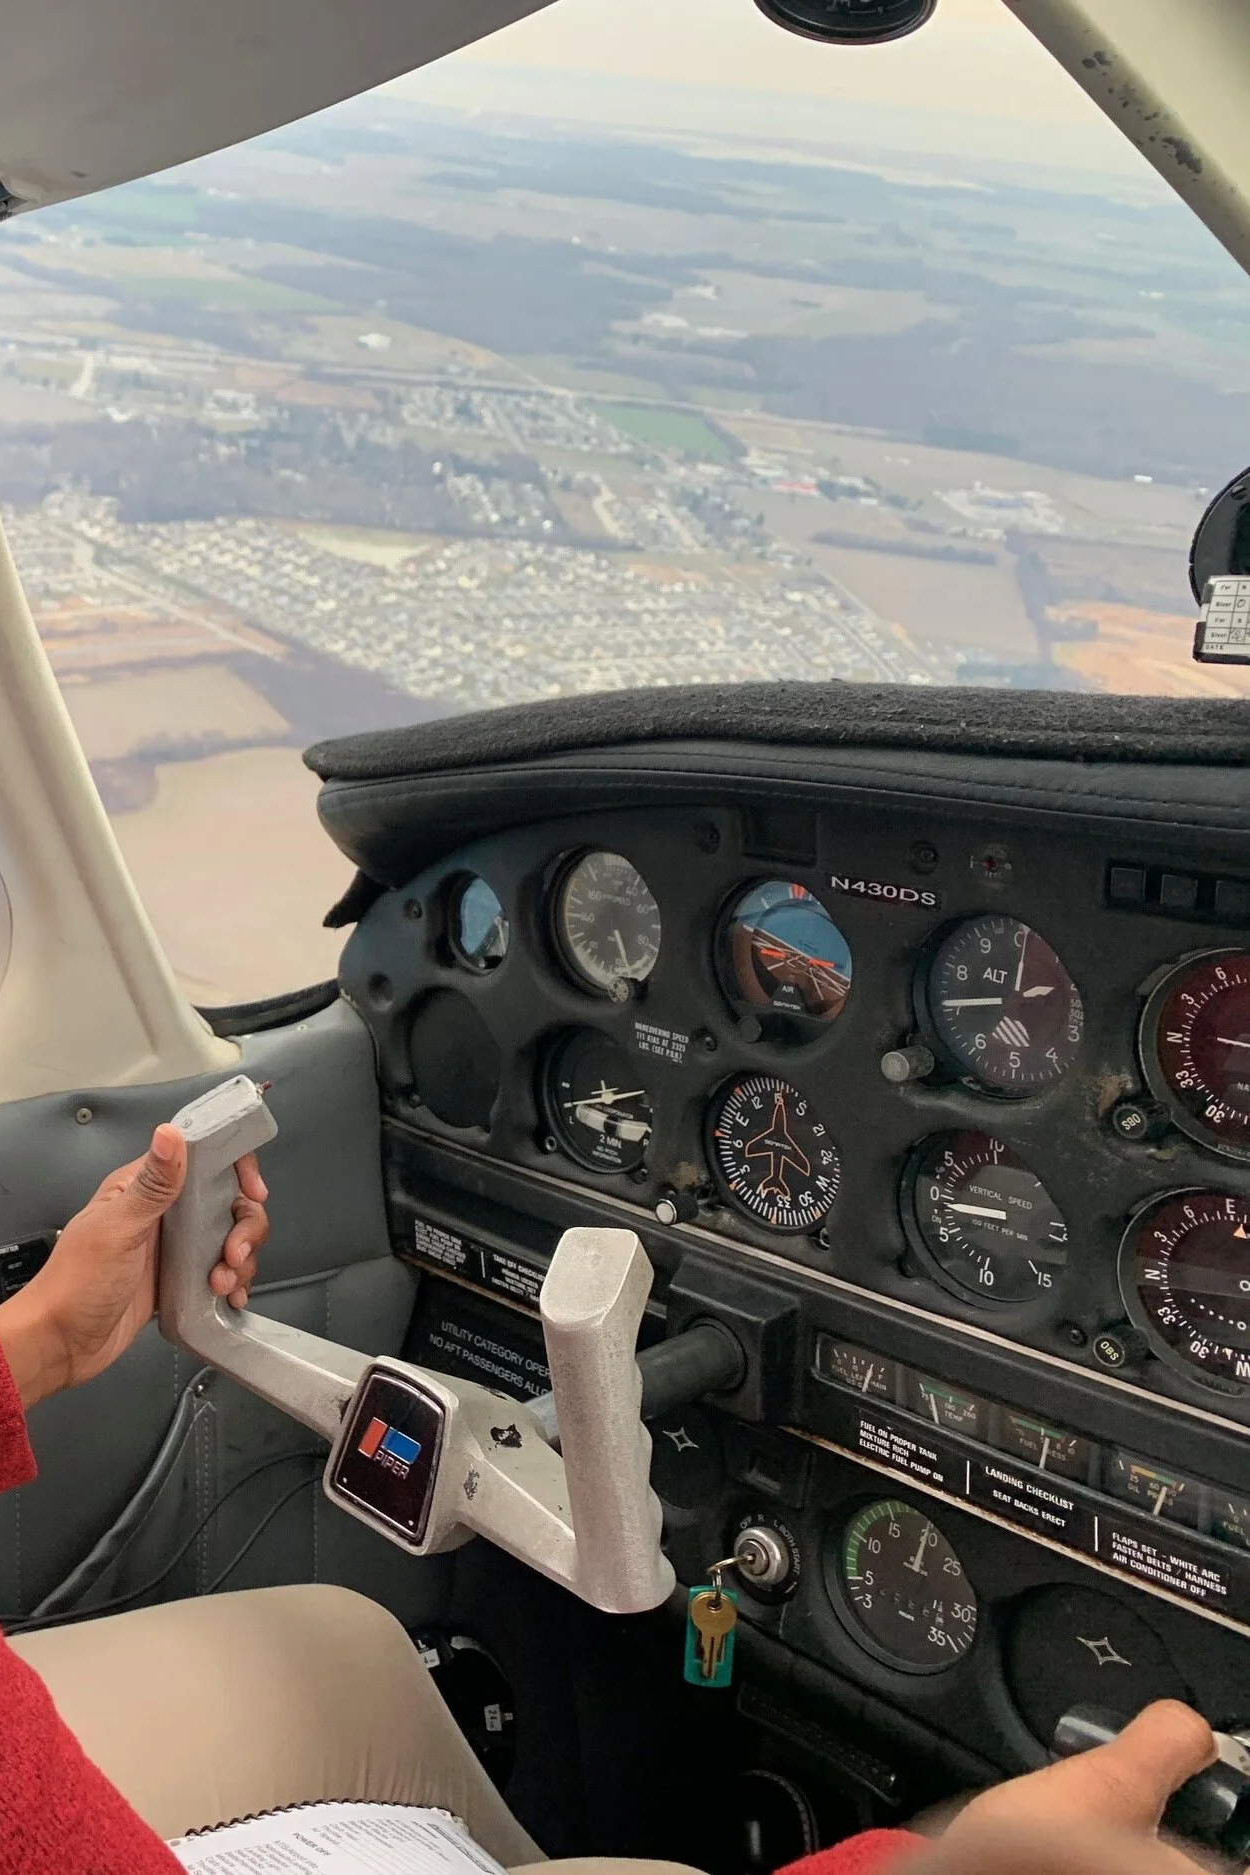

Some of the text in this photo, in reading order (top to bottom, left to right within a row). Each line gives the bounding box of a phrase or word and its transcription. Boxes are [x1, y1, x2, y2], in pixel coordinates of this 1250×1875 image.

[831, 876, 937, 906] N430DS
[637, 904, 648, 914] 60
[980, 938, 991, 954] 9
[957, 965, 968, 981] 8
[983, 967, 1008, 984] ALT
[1215, 967, 1227, 981] 6
[782, 985, 794, 994] AIR
[1181, 993, 1195, 1005] 3
[672, 1032, 689, 1044] SPEED
[1068, 1025, 1080, 1042] 3
[1167, 1032, 1183, 1043] N
[975, 1034, 986, 1050] 6
[1009, 1052, 1021, 1068] 5
[1045, 1048, 1058, 1063] 4
[1176, 1070, 1194, 1089] 33
[751, 1096, 763, 1110] 12
[796, 1102, 807, 1116] S
[570, 1116, 575, 1125] L
[735, 1112, 750, 1127] E
[1205, 1104, 1225, 1123] 30
[813, 1124, 826, 1136] 21
[1121, 1113, 1141, 1131] OBS
[599, 1134, 605, 1143] 2
[732, 1139, 744, 1149] 6
[821, 1150, 833, 1166] 24
[944, 1151, 954, 1166] 5
[739, 1164, 751, 1175] 3
[815, 1175, 831, 1192] W
[798, 1190, 815, 1207] 30
[930, 1186, 940, 1200] 0
[969, 1185, 1033, 1210] VERTICAL SPEED
[777, 1194, 791, 1209] 33
[1226, 1198, 1236, 1215] E
[932, 1216, 941, 1224] DN
[1183, 1205, 1195, 1219] 6
[940, 1227, 949, 1242] 5
[984, 1221, 999, 1232] FEET
[1001, 1228, 1013, 1236] PER
[1154, 1231, 1168, 1243] 3
[979, 1269, 994, 1286] 10
[1038, 1272, 1052, 1287] 15
[1144, 1269, 1161, 1281] N
[1158, 1306, 1176, 1325] 33
[441, 1320, 550, 1378] UTILITY CATEGORY OPER
[1100, 1341, 1119, 1361] OBS
[1190, 1340, 1210, 1359] 30
[430, 1333, 549, 1397] NO AFT PASSENGERS ALLO
[944, 1411, 964, 1422] TEMP
[860, 1420, 938, 1461] FUEL ON PROPER TANK
[860, 1429, 909, 1458] MIXTURE RICH
[1019, 1437, 1038, 1450] FUEL
[374, 1450, 410, 1480] PIPER
[859, 1439, 944, 1482] ELECTRIC FUEL PUMP ON
[985, 1466, 1074, 1511] LANDING CHECKLIST
[1128, 1483, 1141, 1494] OIL
[993, 1489, 1066, 1527] SEAT BACKS ERECT
[773, 1520, 779, 1528] L
[888, 1522, 901, 1538] 15
[1223, 1521, 1246, 1536] FUEL
[779, 1524, 796, 1547] BOTH
[868, 1537, 881, 1554] 10
[792, 1548, 801, 1575] START
[1112, 1532, 1138, 1549] FLAPS
[1141, 1544, 1158, 1557] SET
[1170, 1555, 1198, 1574] WHITE
[1201, 1569, 1221, 1582] ARC
[943, 1557, 961, 1577] 25
[1112, 1541, 1144, 1560] FASTEN
[1146, 1556, 1172, 1572] BELTS
[1185, 1572, 1227, 1595] HARNESS
[1112, 1552, 1207, 1597] AIR CONDITIONER OFF
[865, 1571, 874, 1586] 5
[863, 1594, 872, 1609] 3
[951, 1603, 971, 1623] 30
[927, 1626, 946, 1647] 35
[291, 1832, 331, 1856] POWER OFF
